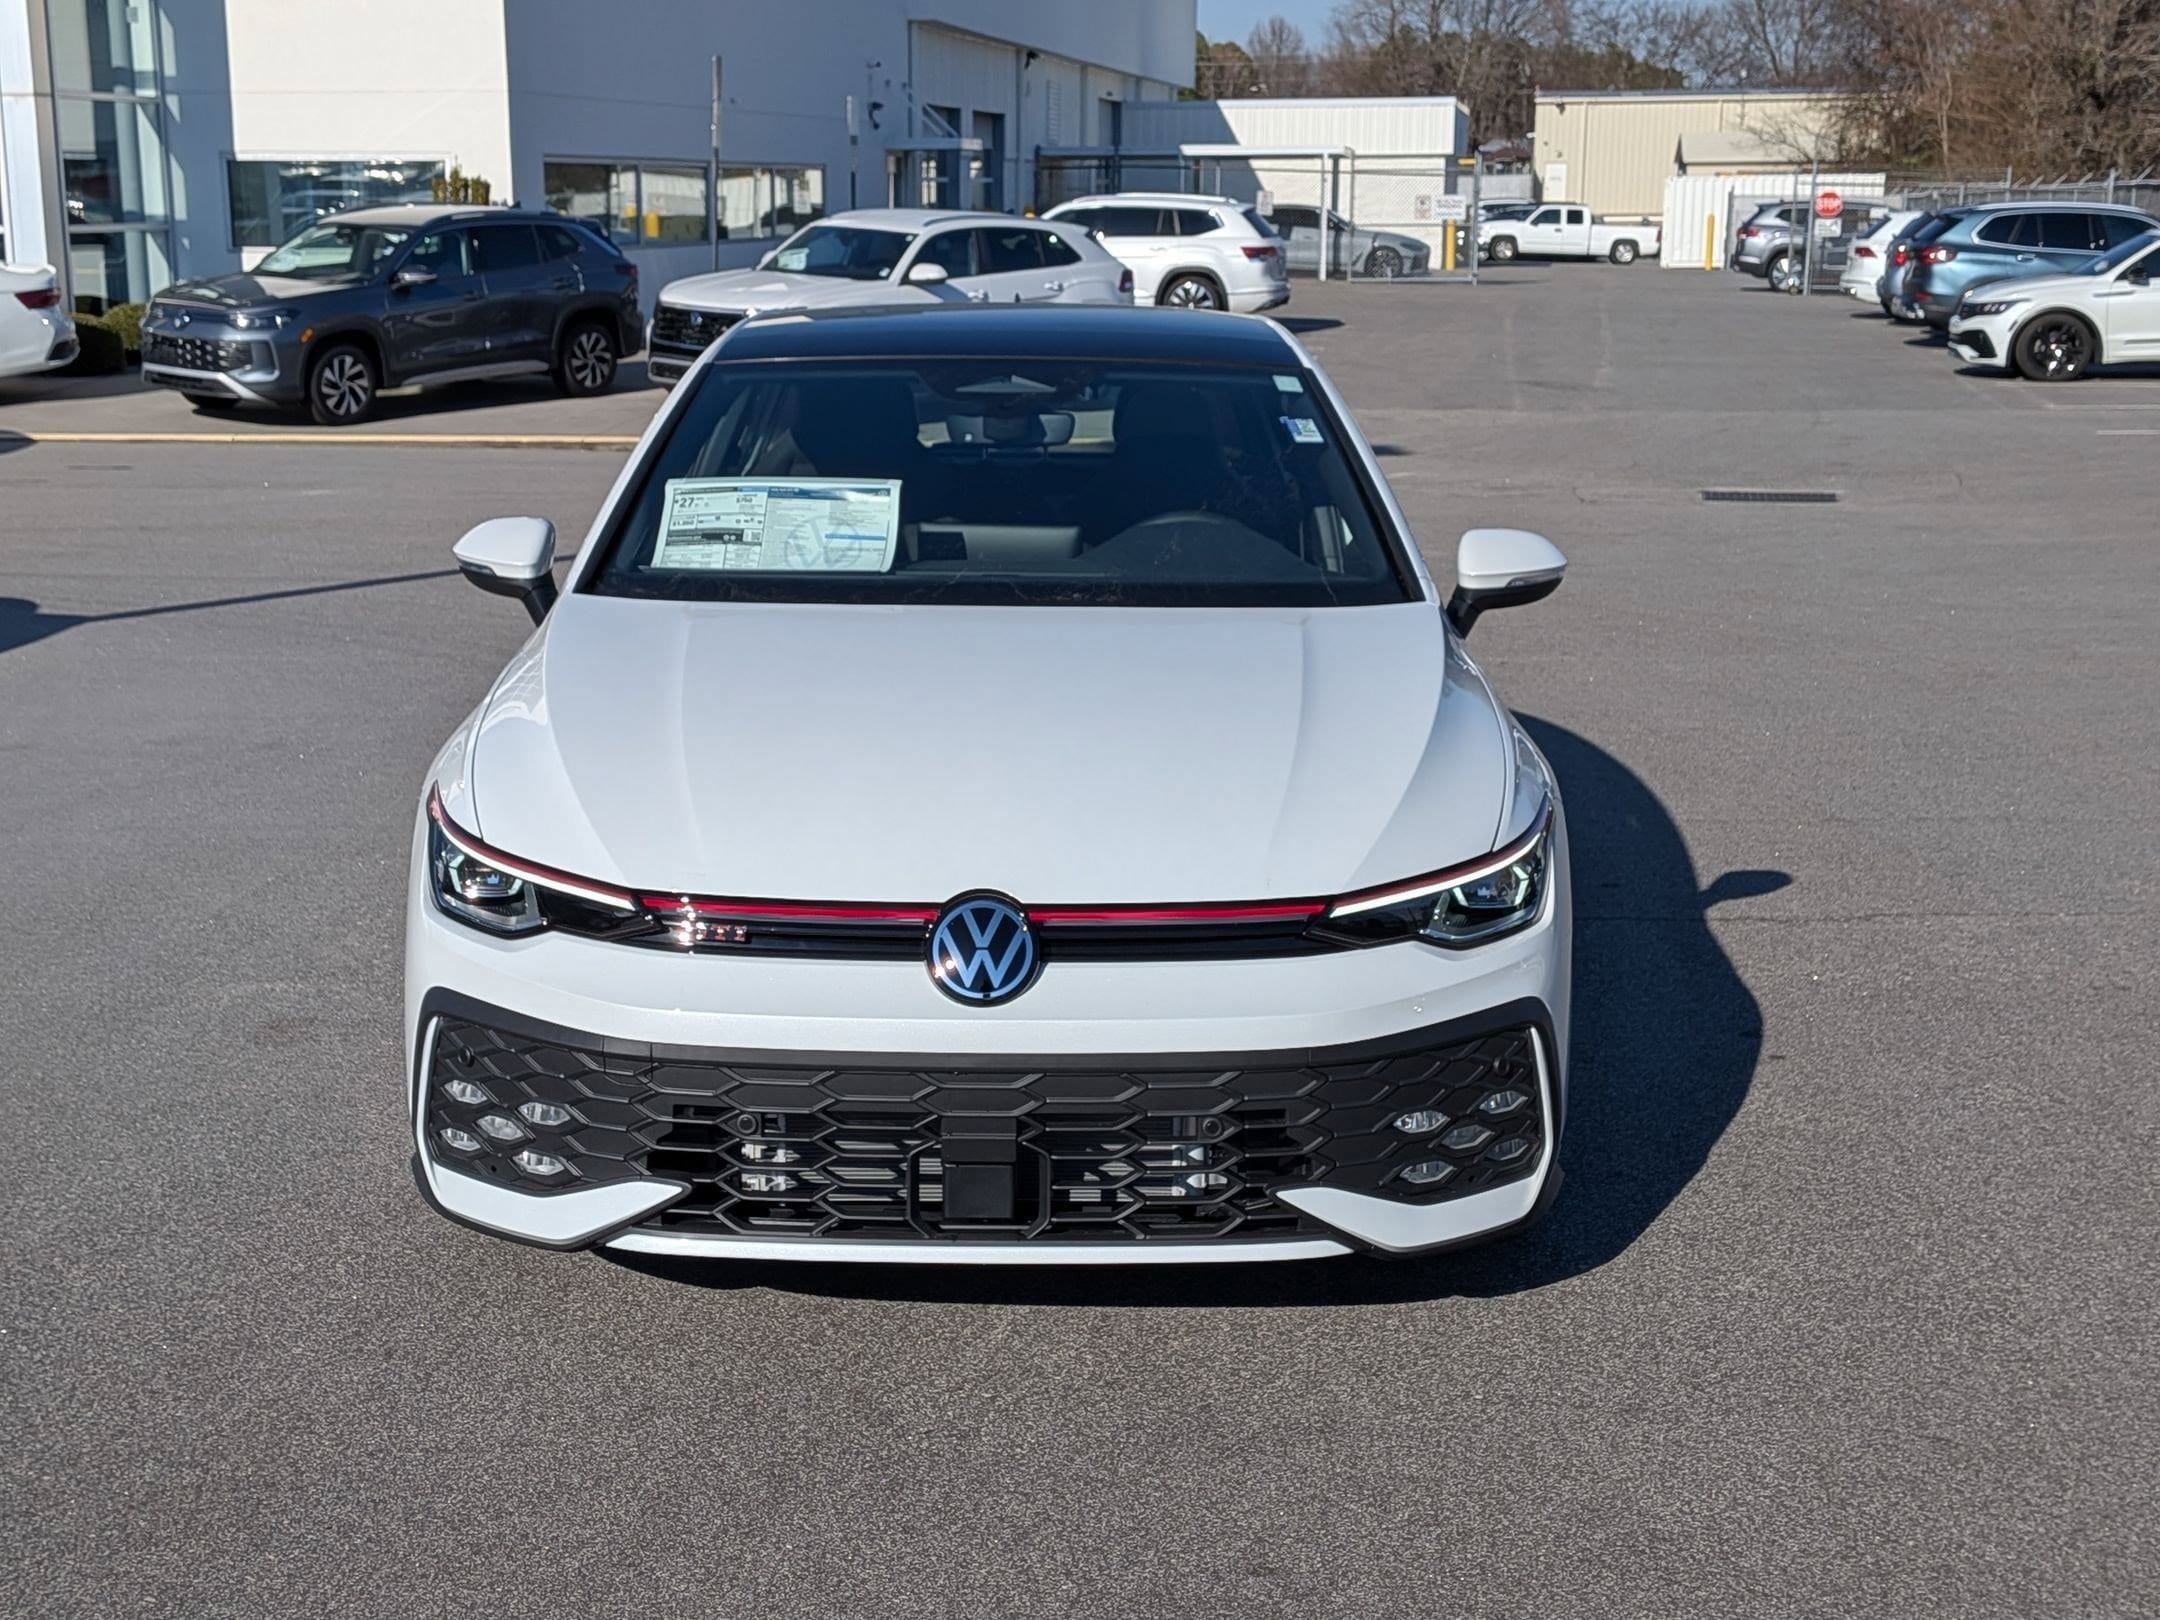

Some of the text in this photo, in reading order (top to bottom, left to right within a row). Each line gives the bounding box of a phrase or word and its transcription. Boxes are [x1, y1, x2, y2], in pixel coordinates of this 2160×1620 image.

[1816, 197, 1842, 210] STOP
[679, 496, 695, 509] 27
[933, 901, 1033, 998] VW
